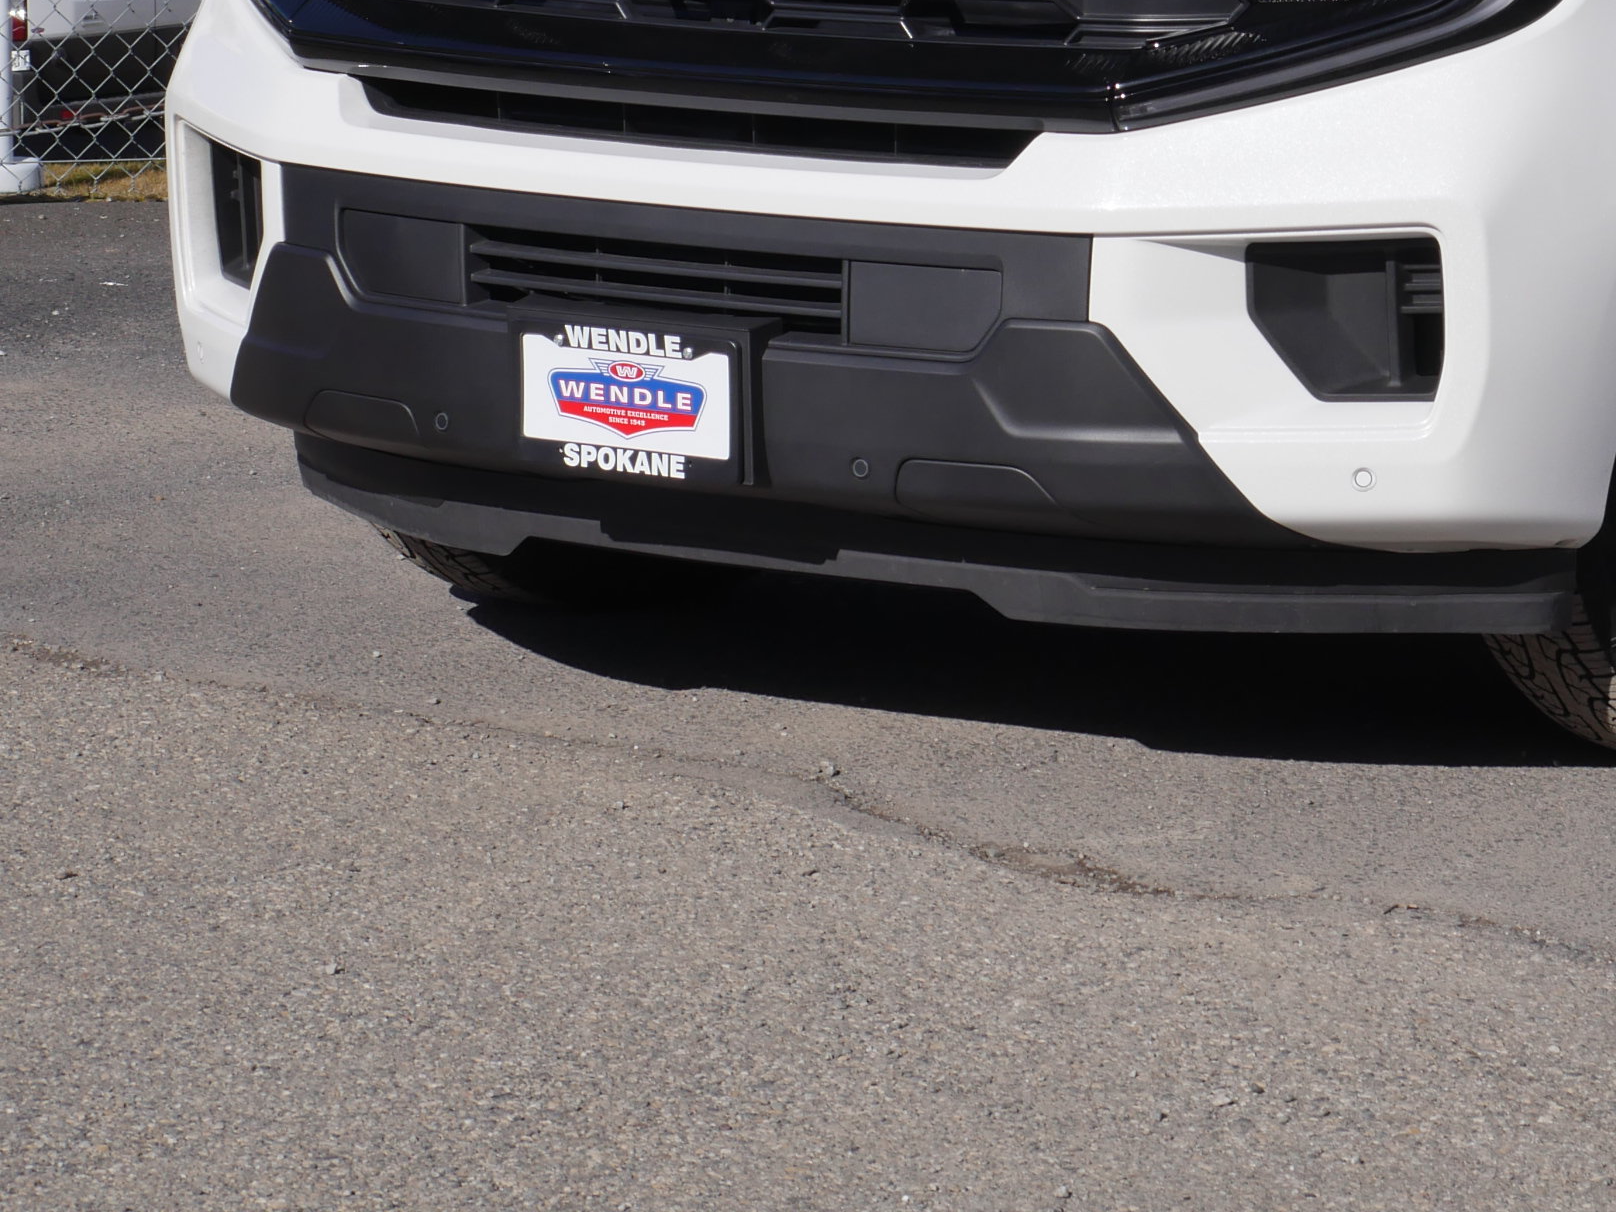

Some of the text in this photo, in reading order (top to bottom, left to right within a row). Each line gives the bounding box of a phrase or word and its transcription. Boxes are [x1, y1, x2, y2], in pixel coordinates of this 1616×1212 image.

[564, 324, 683, 359] WENDLE
[615, 365, 638, 378] W
[559, 379, 692, 411] WENDLE
[583, 405, 669, 422] AUTOMOTIVE EXCELLENCE
[608, 416, 629, 425] SINCE
[563, 442, 685, 479] SPOKANE
